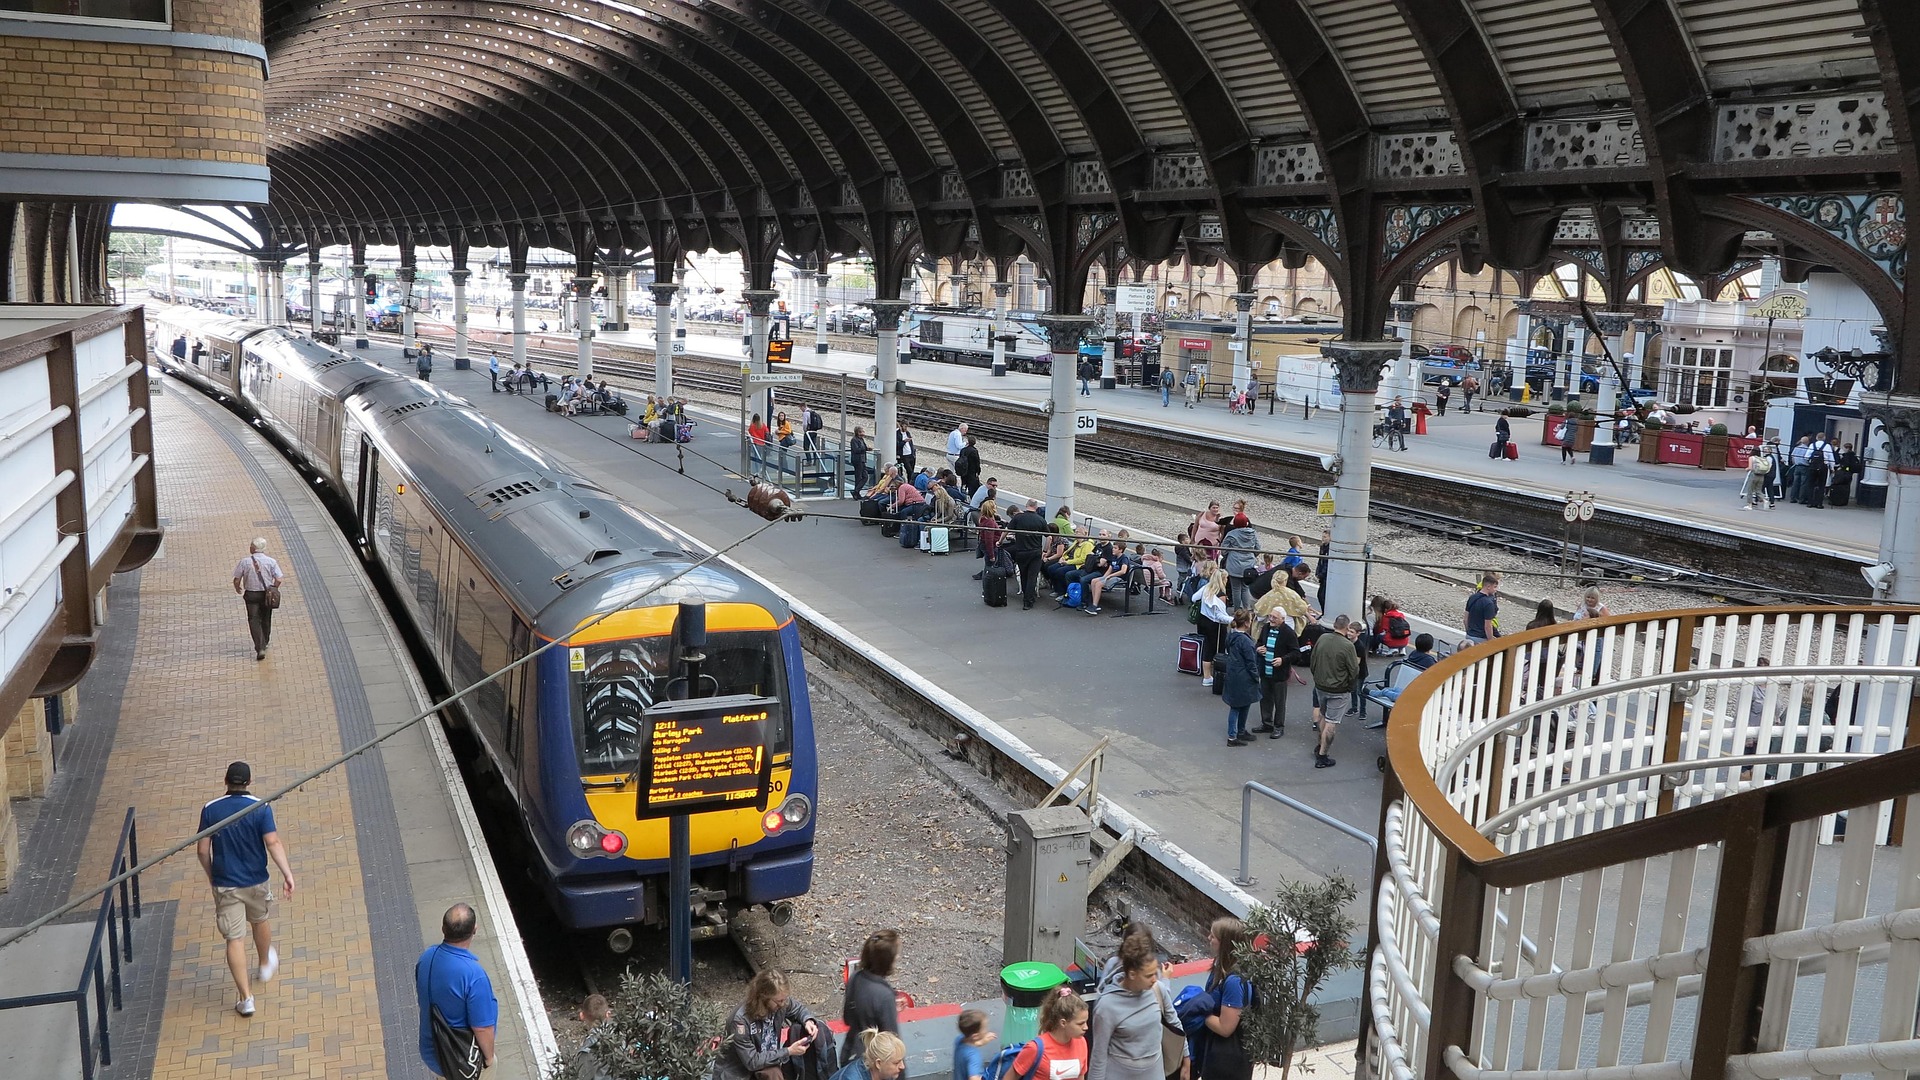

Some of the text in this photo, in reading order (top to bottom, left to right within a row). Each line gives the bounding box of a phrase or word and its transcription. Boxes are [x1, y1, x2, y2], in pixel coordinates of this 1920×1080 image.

[1759, 308, 1790, 319] YORK
[673, 344, 685, 353] 5b
[1077, 415, 1095, 429] 5b
[1566, 507, 1577, 517] 30
[1582, 506, 1592, 516] 15
[722, 714, 759, 724] Platform
[655, 720, 677, 730] 12:11
[653, 727, 703, 739] Burley Park
[662, 737, 691, 745] Harrogate
[654, 755, 682, 763] Poppleton
[695, 756, 734, 765] Knaresborough
[700, 764, 728, 773] Harrogate
